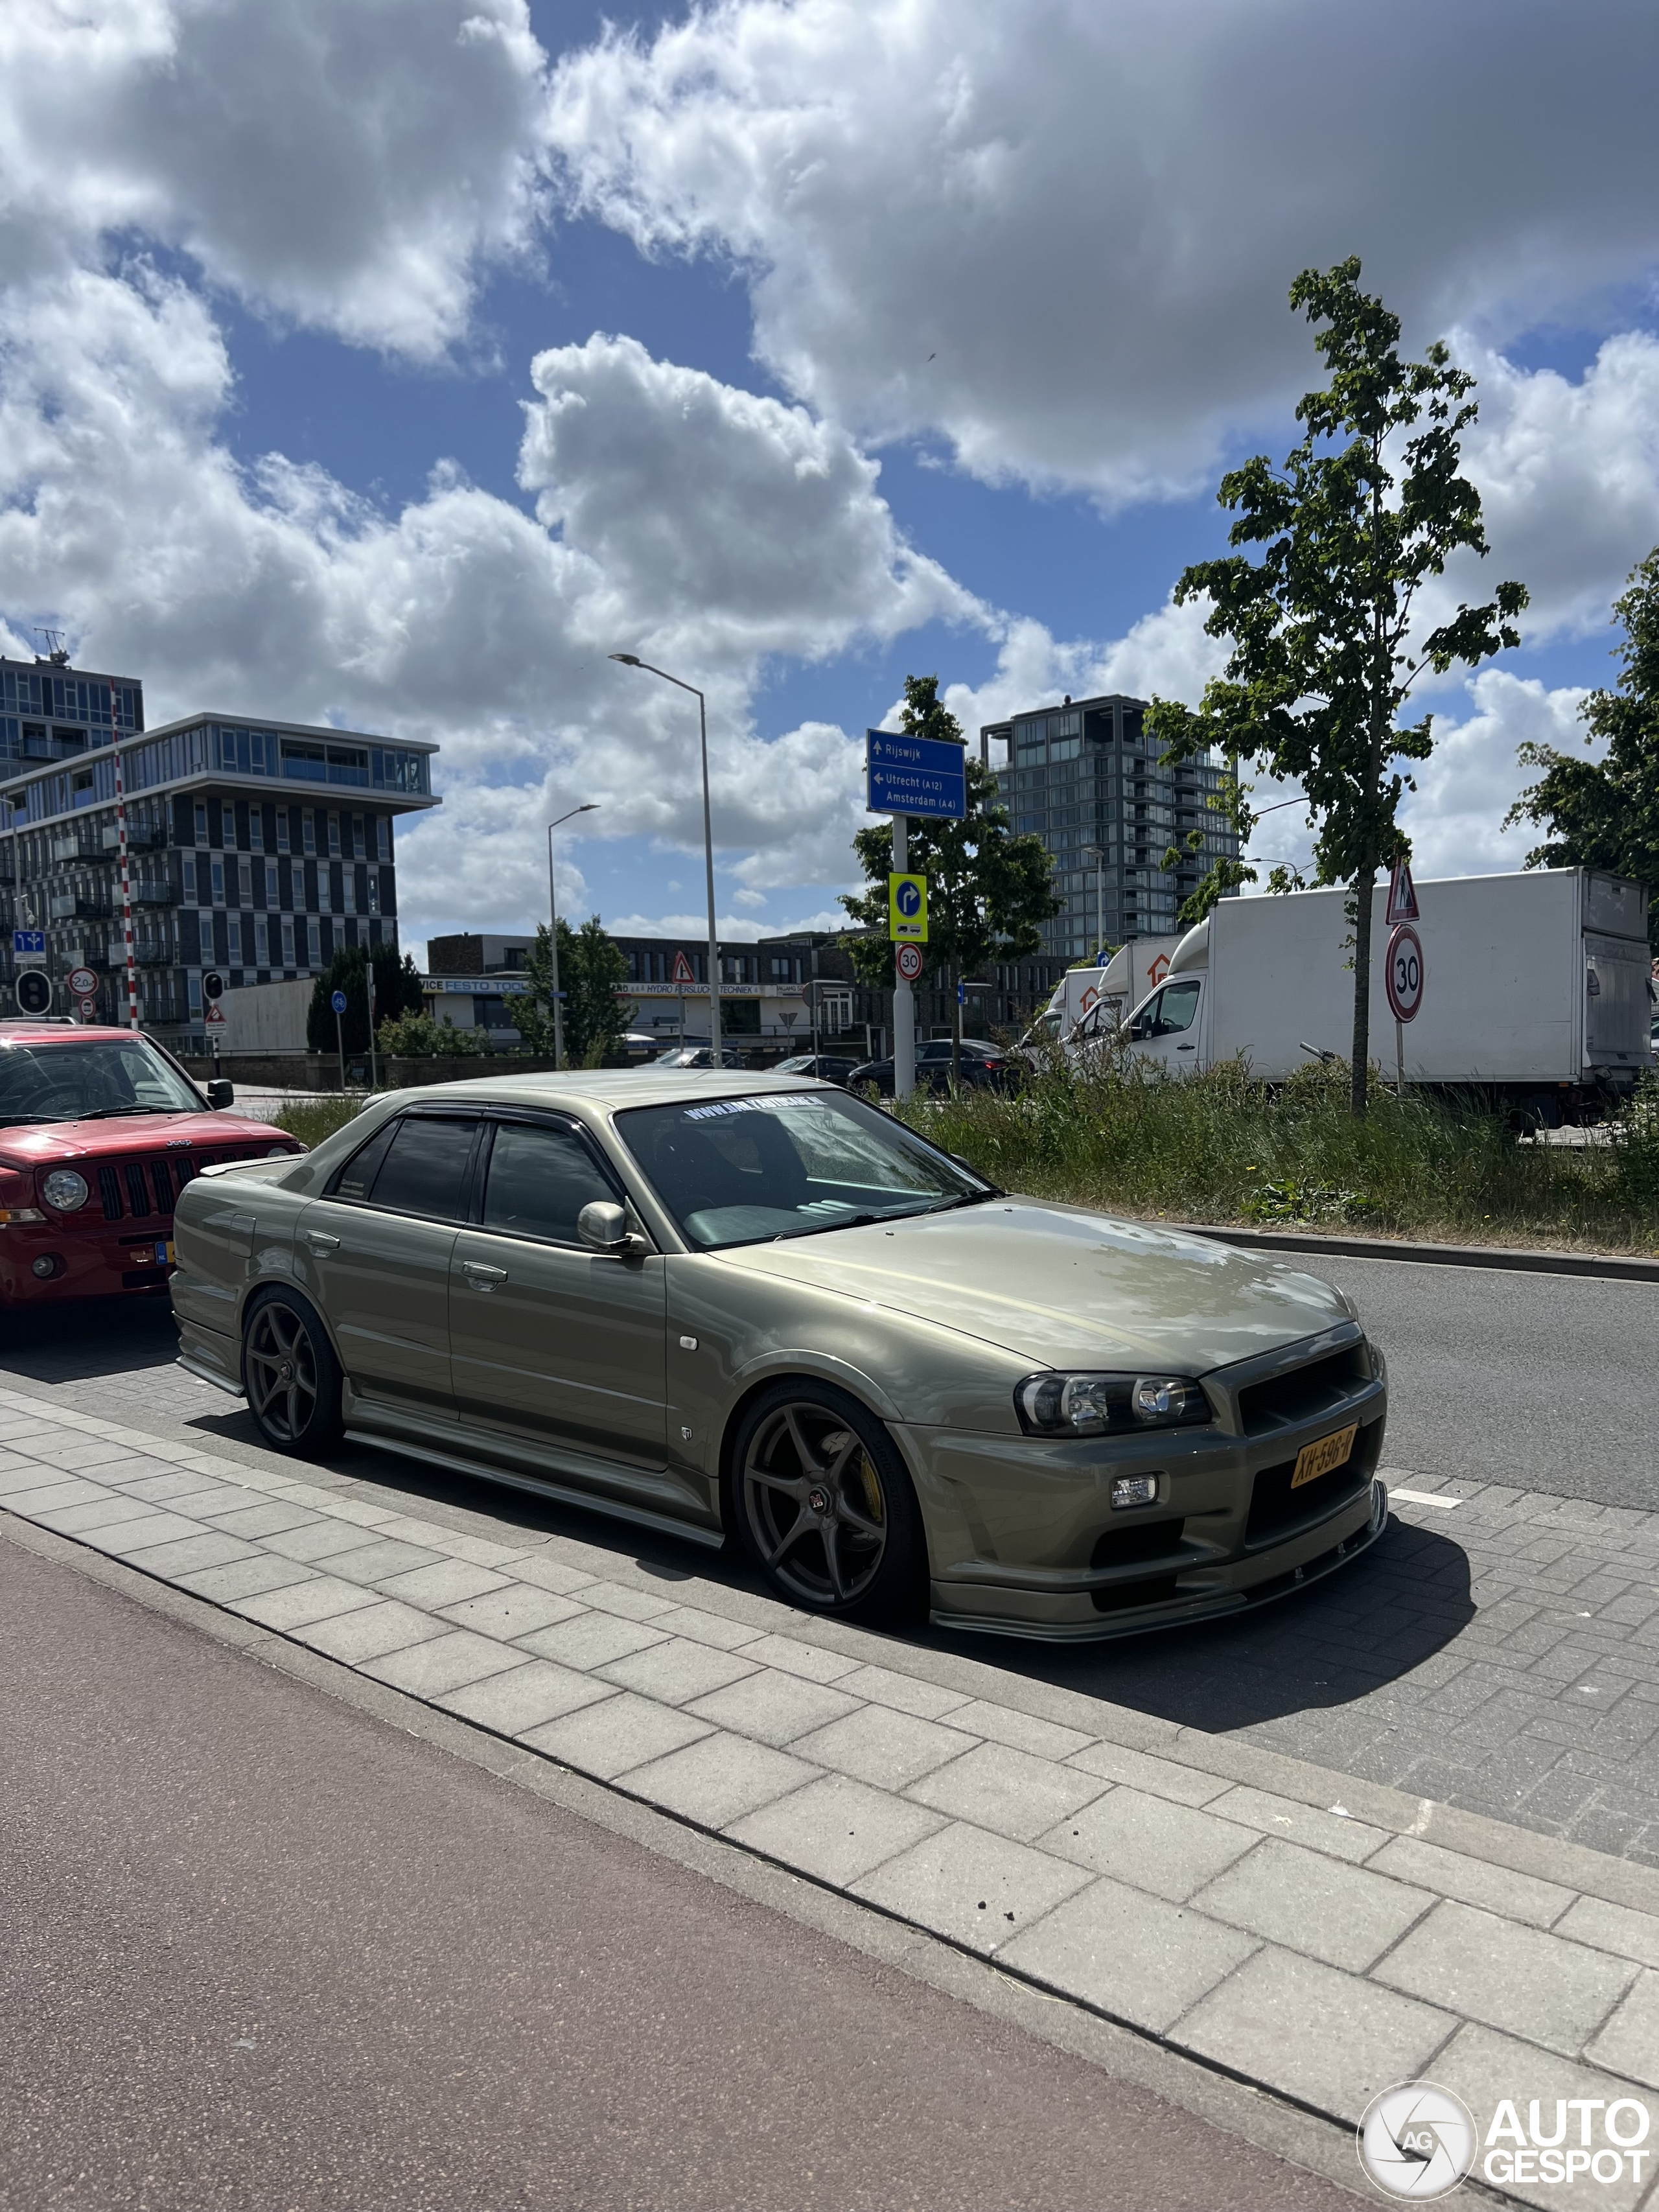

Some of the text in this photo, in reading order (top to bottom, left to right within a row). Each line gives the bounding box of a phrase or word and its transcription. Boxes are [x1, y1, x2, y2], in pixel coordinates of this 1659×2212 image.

[886, 744, 920, 761] Rijswijk
[886, 773, 920, 787] Utrecht
[887, 791, 936, 806] Amsterdam
[902, 954, 918, 968] 30
[1396, 955, 1419, 994] 30
[445, 981, 489, 990] FESTO
[647, 985, 672, 994] HYDRO
[719, 985, 752, 994] TECHNIEK
